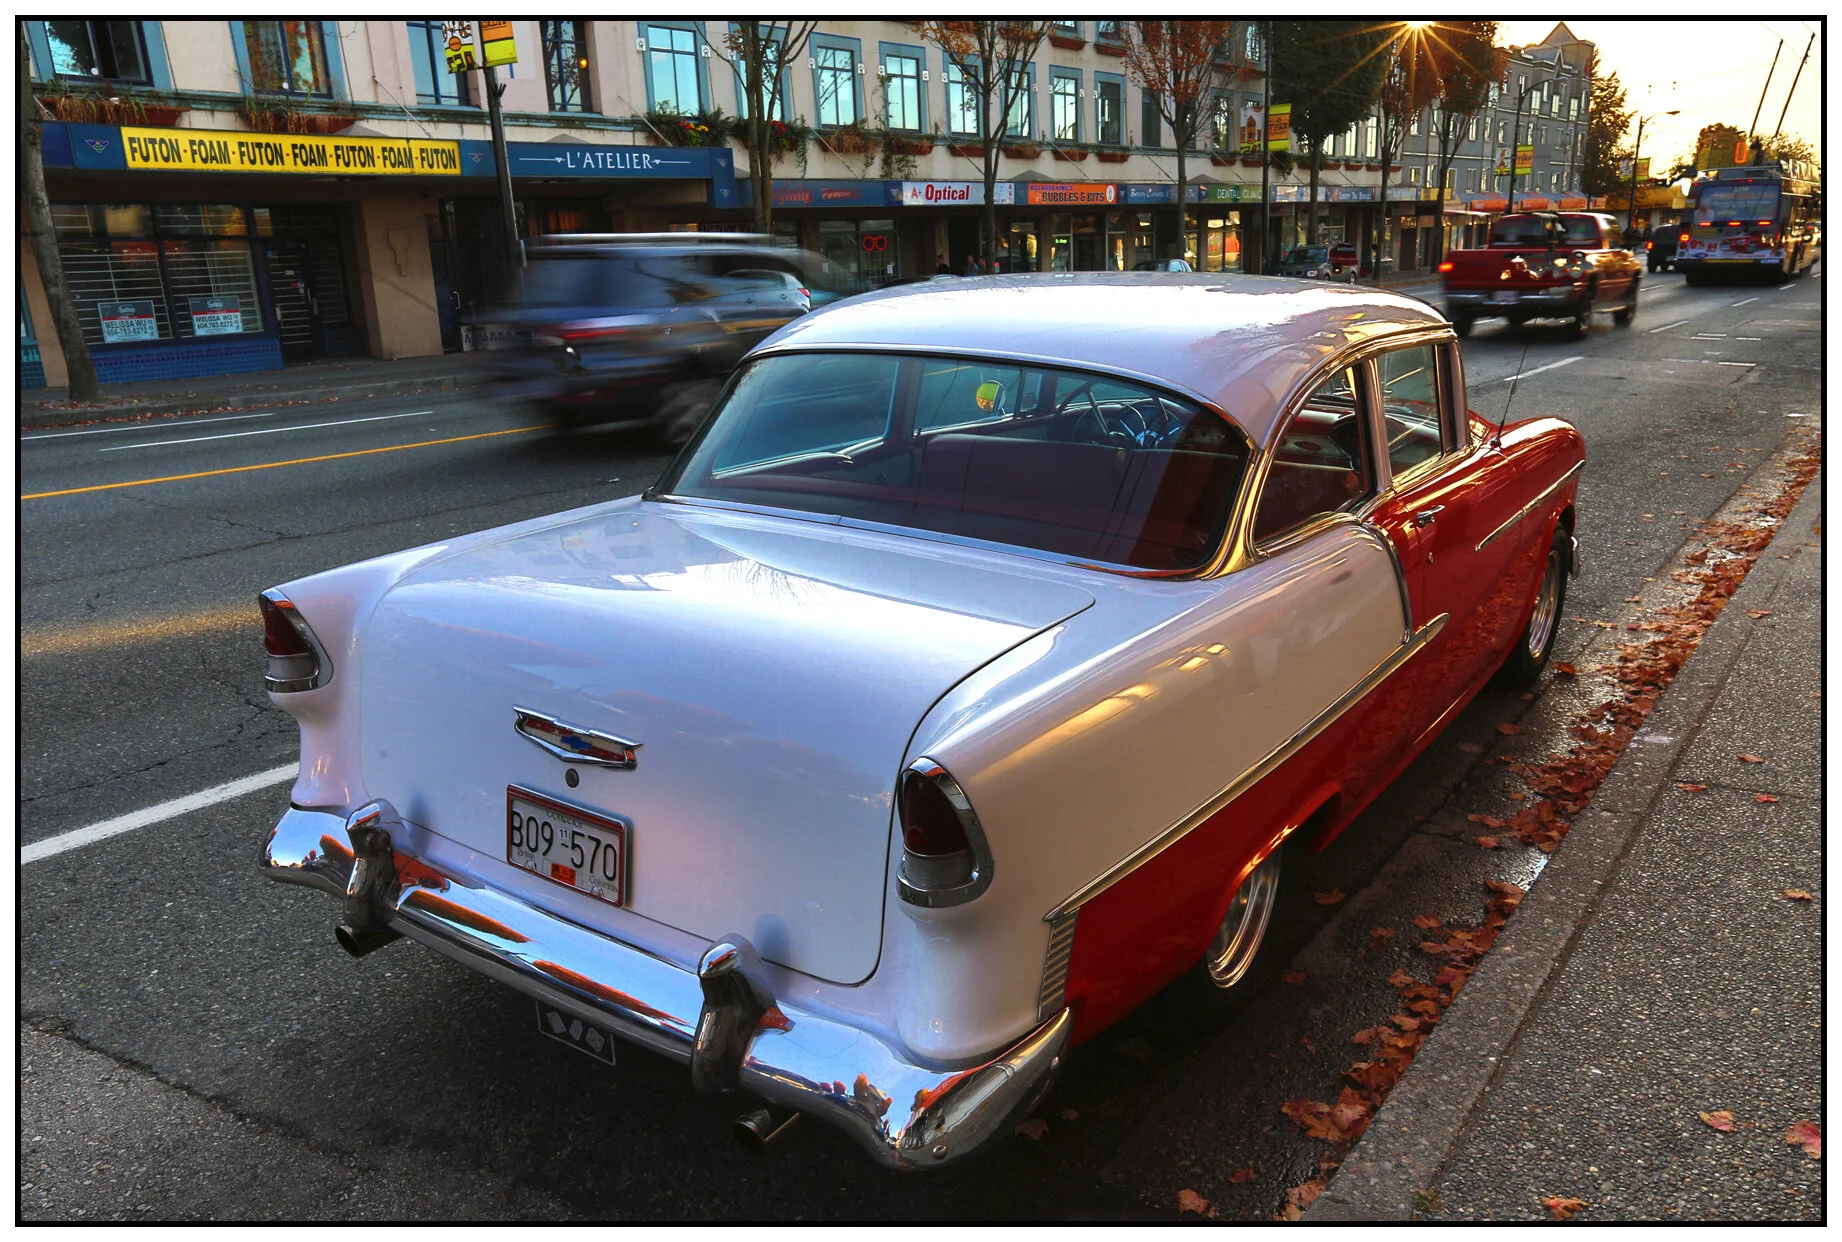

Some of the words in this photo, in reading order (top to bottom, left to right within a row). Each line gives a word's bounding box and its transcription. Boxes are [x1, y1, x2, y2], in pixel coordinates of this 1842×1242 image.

[128, 137, 182, 163] FUTON
[188, 139, 231, 164] FOAM
[237, 141, 285, 166] FUTON
[291, 143, 328, 167] FOAM
[334, 145, 376, 168] FUTON
[381, 146, 414, 169] FOAM
[420, 147, 457, 170] FUTON
[566, 151, 653, 169] L'ATELIER
[925, 183, 971, 203] Optical
[1042, 191, 1079, 203] BUBBLES
[1087, 191, 1105, 203] BITS
[1217, 188, 1241, 199] DENTAL
[105, 319, 135, 329] MELISSA
[136, 319, 147, 327] WU
[196, 315, 221, 323] MELISSA
